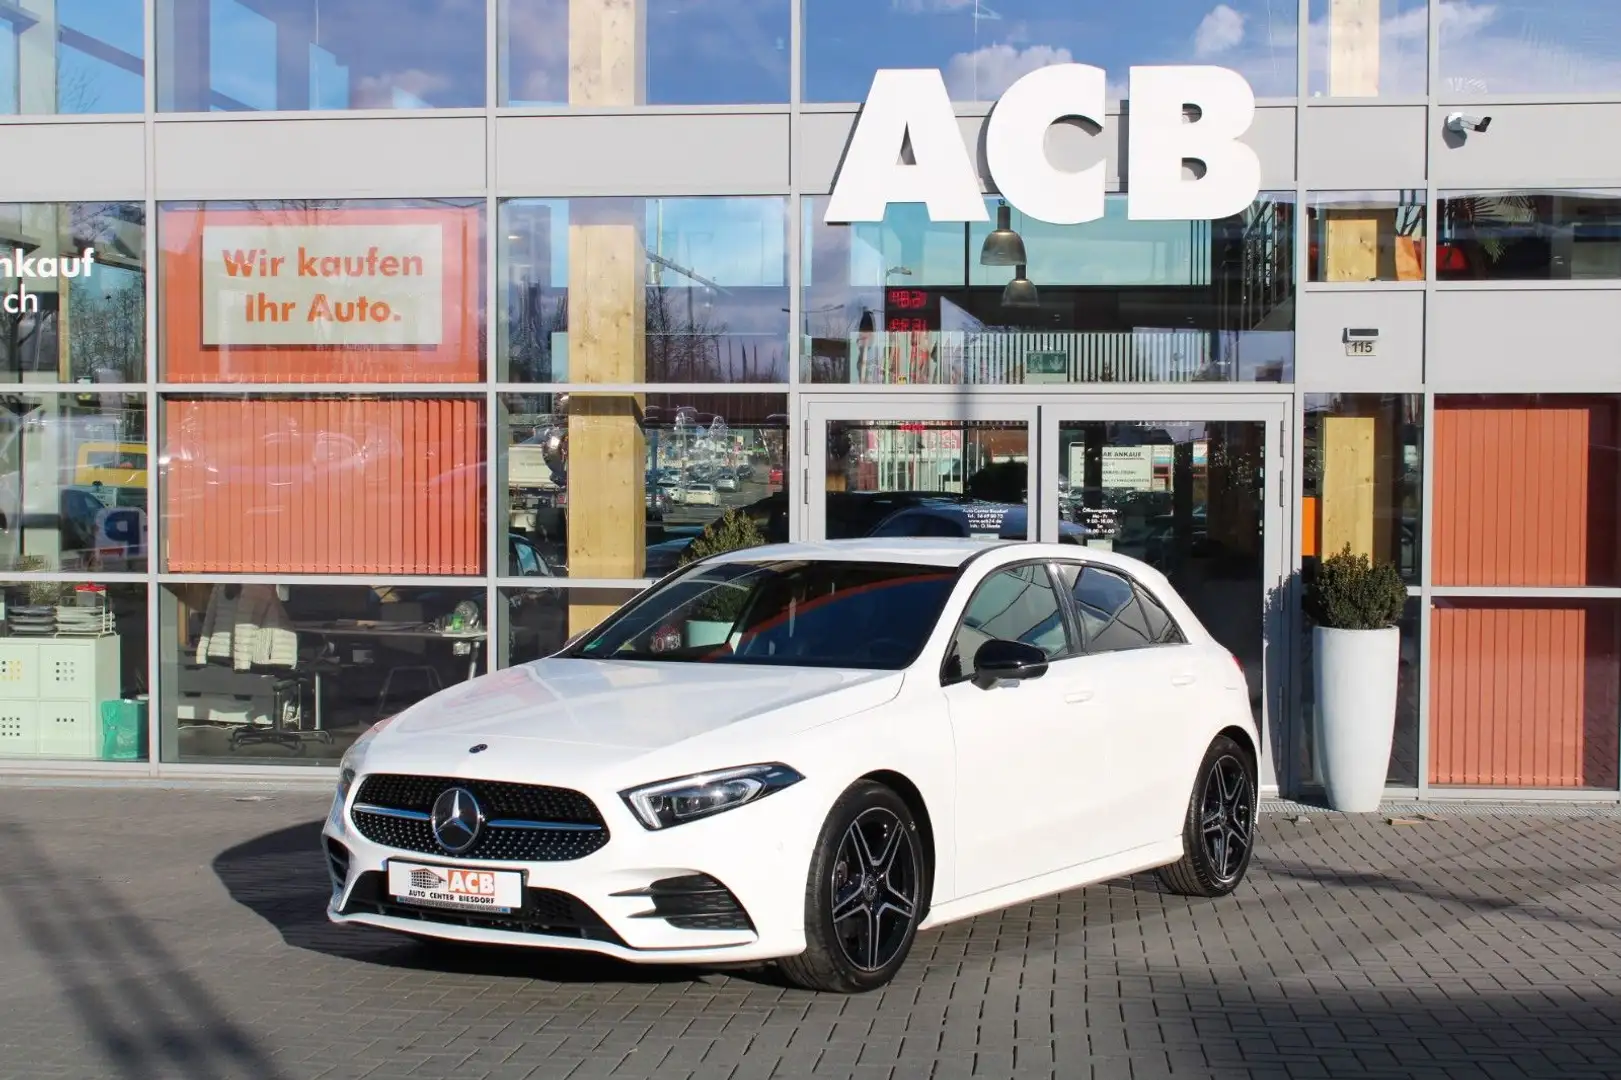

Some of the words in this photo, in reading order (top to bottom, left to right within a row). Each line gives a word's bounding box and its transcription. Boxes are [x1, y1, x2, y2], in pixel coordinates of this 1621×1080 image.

[823, 63, 1261, 224] ACB
[222, 249, 285, 278] Wir
[298, 247, 423, 278] kaufen
[3, 283, 38, 314] ch
[245, 292, 296, 323] Ihr
[306, 293, 402, 323] Auto.
[1351, 341, 1373, 353] 115
[408, 889, 426, 898] AUTO
[429, 891, 455, 901] CENTER
[458, 894, 495, 904] BIESDORF
[448, 870, 495, 895] ACB
